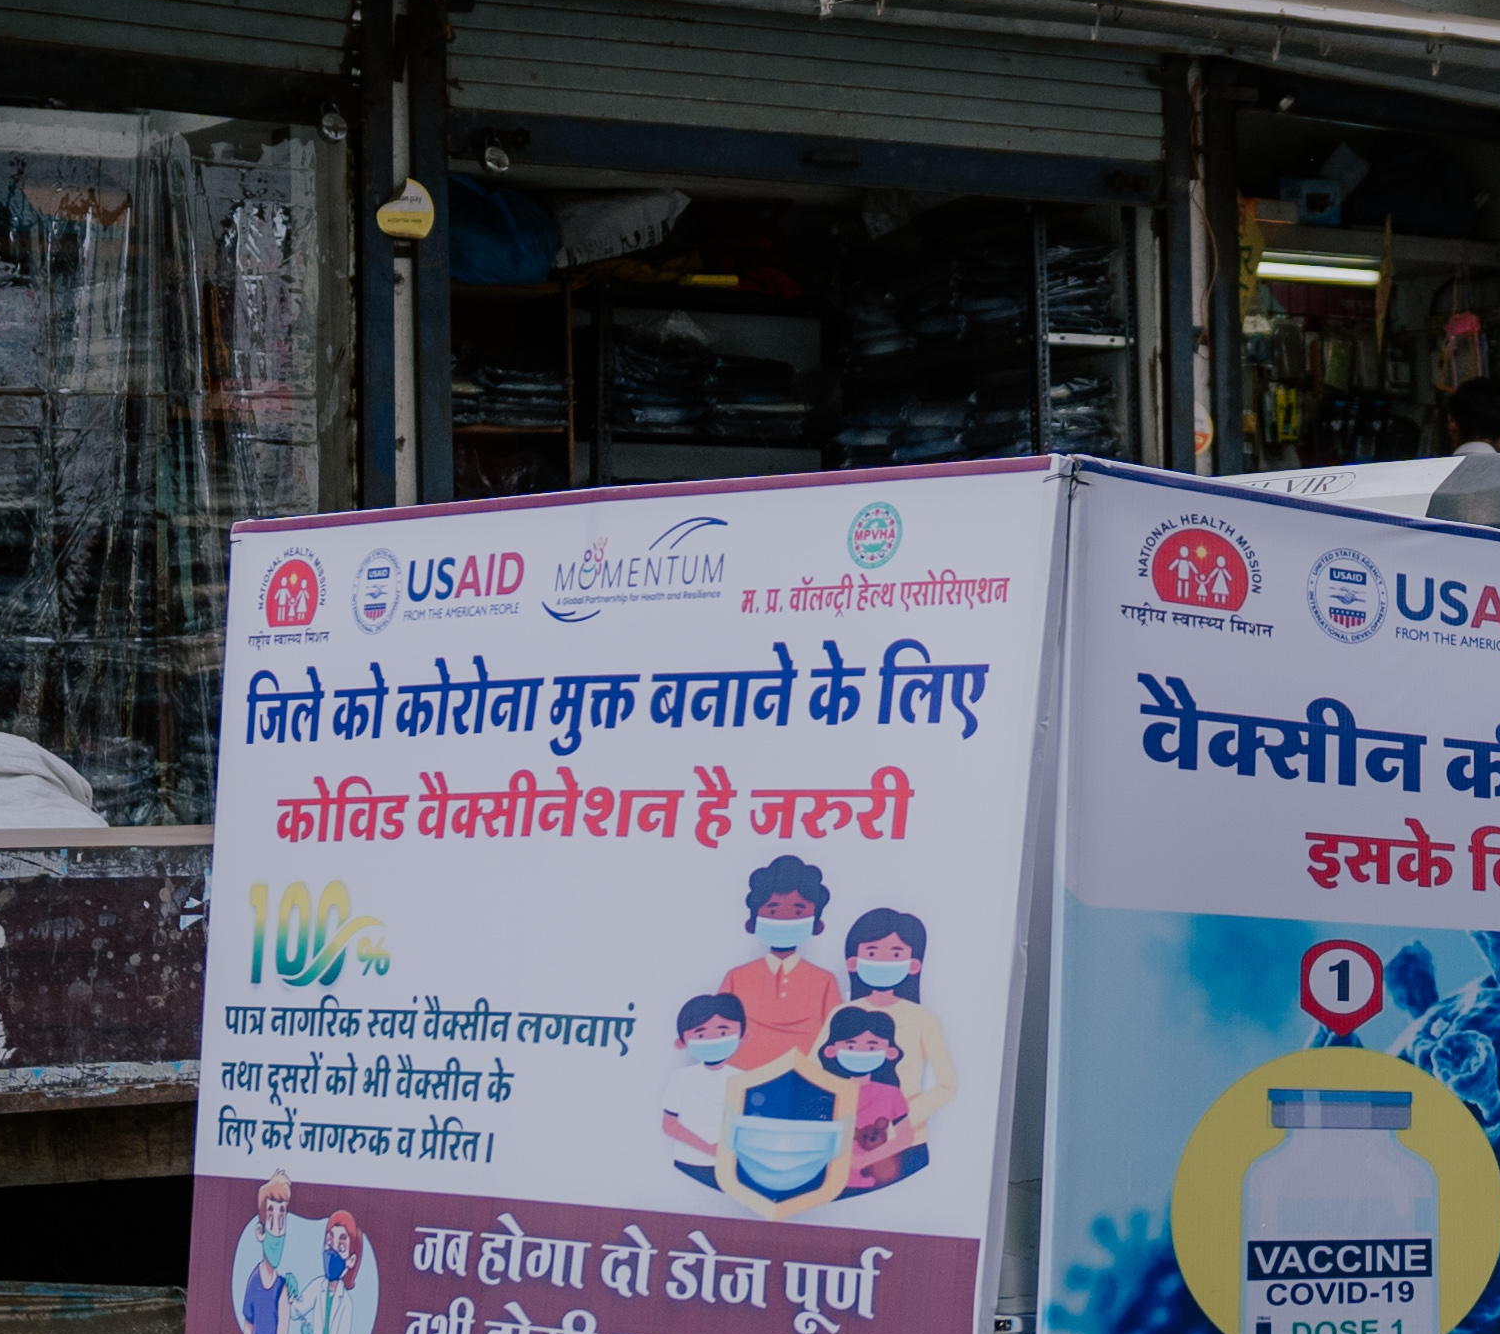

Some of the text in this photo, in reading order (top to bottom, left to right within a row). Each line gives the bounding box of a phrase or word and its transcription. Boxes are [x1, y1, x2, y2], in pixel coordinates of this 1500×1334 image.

[854, 528, 895, 540] MPVHA
[1138, 514, 1262, 594] NATIONAL HEALTH MISSION
[284, 546, 327, 606] HEALTH MISSION
[408, 552, 524, 602] USAID
[555, 553, 724, 591] MOMENTUM
[857, 569, 1010, 611] हेल्थ एसोसिएशन
[1333, 570, 1363, 582] USAID
[403, 610, 426, 621] FROM
[1230, 615, 1274, 637] मिशन
[1395, 626, 1431, 642] FROM
[1435, 631, 1457, 645] THE
[246, 638, 989, 756] जिले को कोरोना मुक्त बनाने के लिए
[1137, 673, 1427, 792] वैक्सीन
[276, 766, 914, 849] कोविड वैक्सीनेशन है जरुरी
[1305, 818, 1455, 889] इसके
[1328, 957, 1351, 1004] 1
[225, 994, 636, 1057] पात्र नागरिक स्वयं वैक्सीन लगवाएं
[222, 1051, 514, 1106] तथा दूसरों को भी वैक्सीन के
[218, 1105, 416, 1159] लिए करें व
[412, 1212, 893, 1334] जब होगा दो डोज पूर्ण
[1254, 1245, 1427, 1274] VACCINE
[1267, 1281, 1414, 1306] COVID-19
